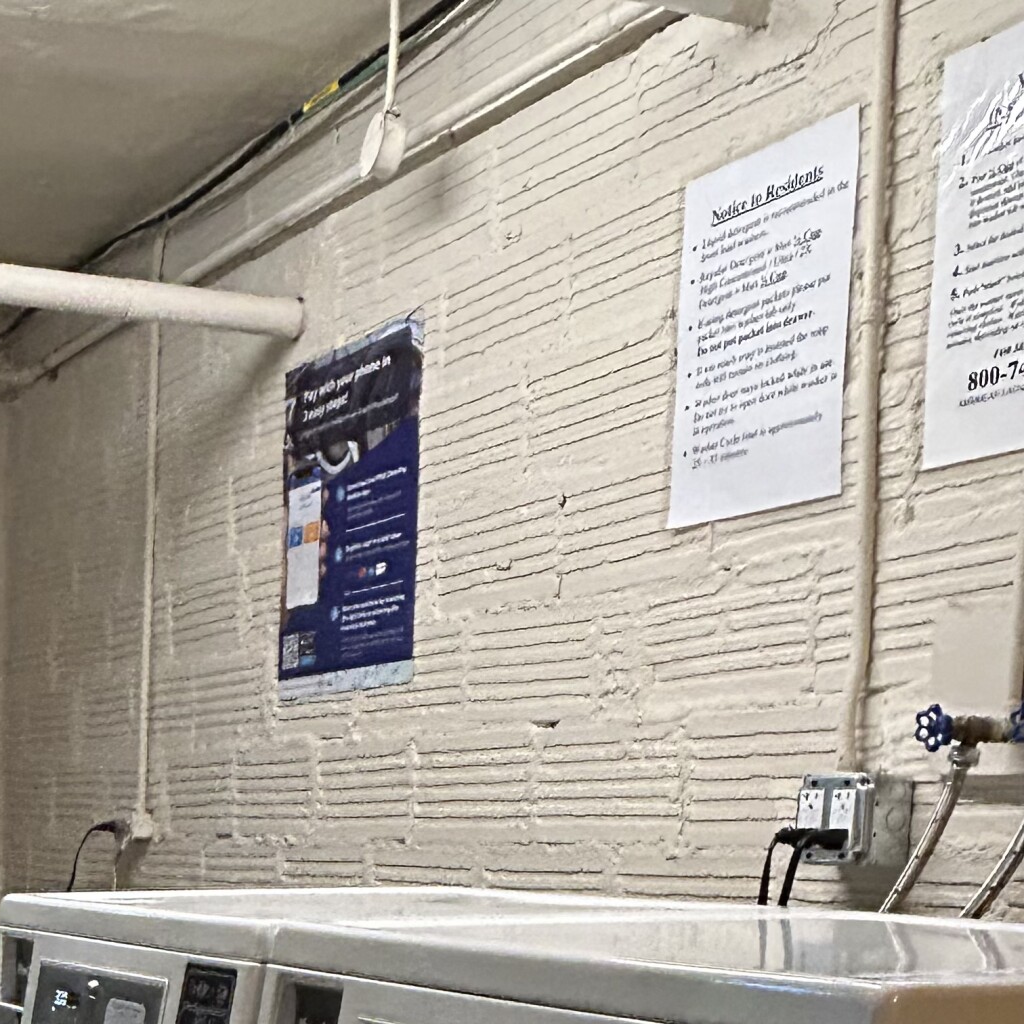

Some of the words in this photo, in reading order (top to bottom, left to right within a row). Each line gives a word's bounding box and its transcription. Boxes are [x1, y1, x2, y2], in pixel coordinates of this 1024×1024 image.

[711, 199, 747, 223] Notice
[750, 193, 762, 206] to
[765, 165, 823, 200] Residents
